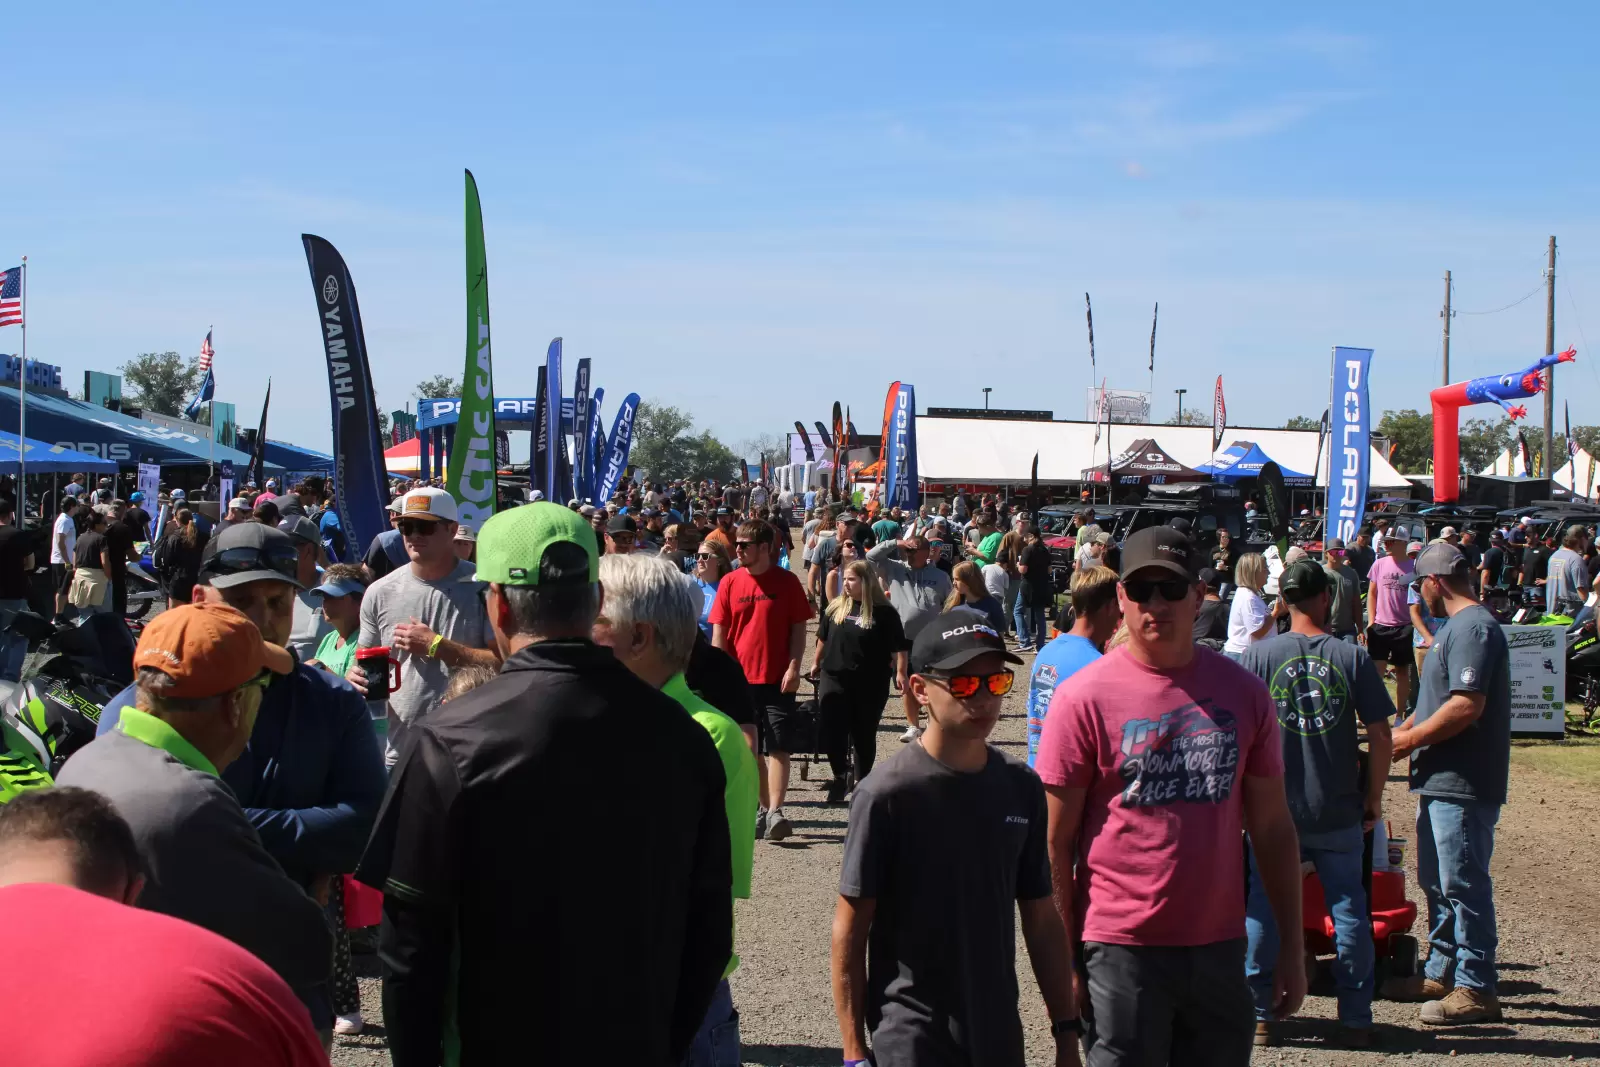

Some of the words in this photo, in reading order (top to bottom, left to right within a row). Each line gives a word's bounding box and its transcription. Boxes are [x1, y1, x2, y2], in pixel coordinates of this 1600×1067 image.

[324, 305, 356, 411] YAMAHA
[475, 316, 493, 400] CAT
[600, 402, 633, 503] POLARIS
[895, 391, 910, 502] POLARIS
[1336, 359, 1361, 547] POLARIS
[1151, 475, 1166, 485] THE
[1285, 661, 1328, 678] CAT'S
[1286, 709, 1335, 729] PRIDE
[1172, 735, 1189, 752] THE
[1192, 732, 1217, 747] MOST
[1217, 730, 1236, 746] FUN
[1123, 747, 1238, 777] SNOWMOBILE
[1126, 778, 1180, 802] RACE
